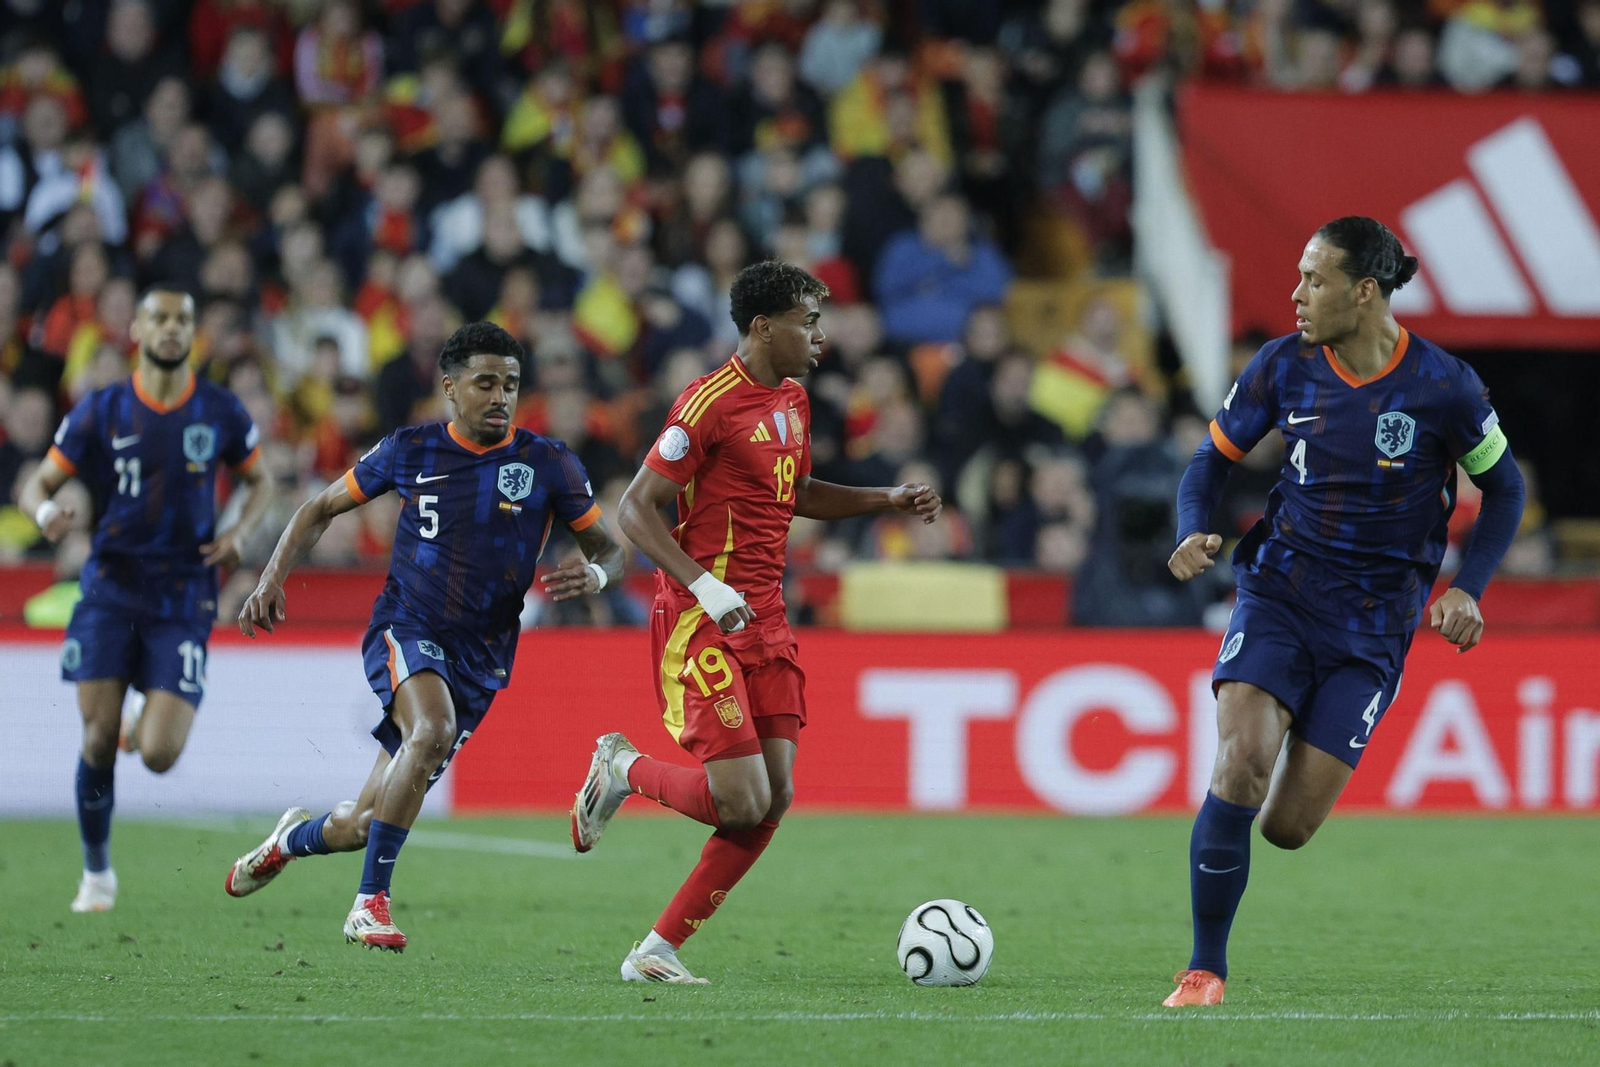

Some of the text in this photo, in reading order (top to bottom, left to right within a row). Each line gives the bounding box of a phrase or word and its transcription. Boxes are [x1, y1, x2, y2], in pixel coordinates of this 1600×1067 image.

[114, 457, 142, 497] 11
[773, 455, 796, 502] 19
[1290, 439, 1307, 485] 4
[418, 495, 439, 539] 5
[682, 646, 733, 697] 19
[1362, 691, 1382, 736] 4
